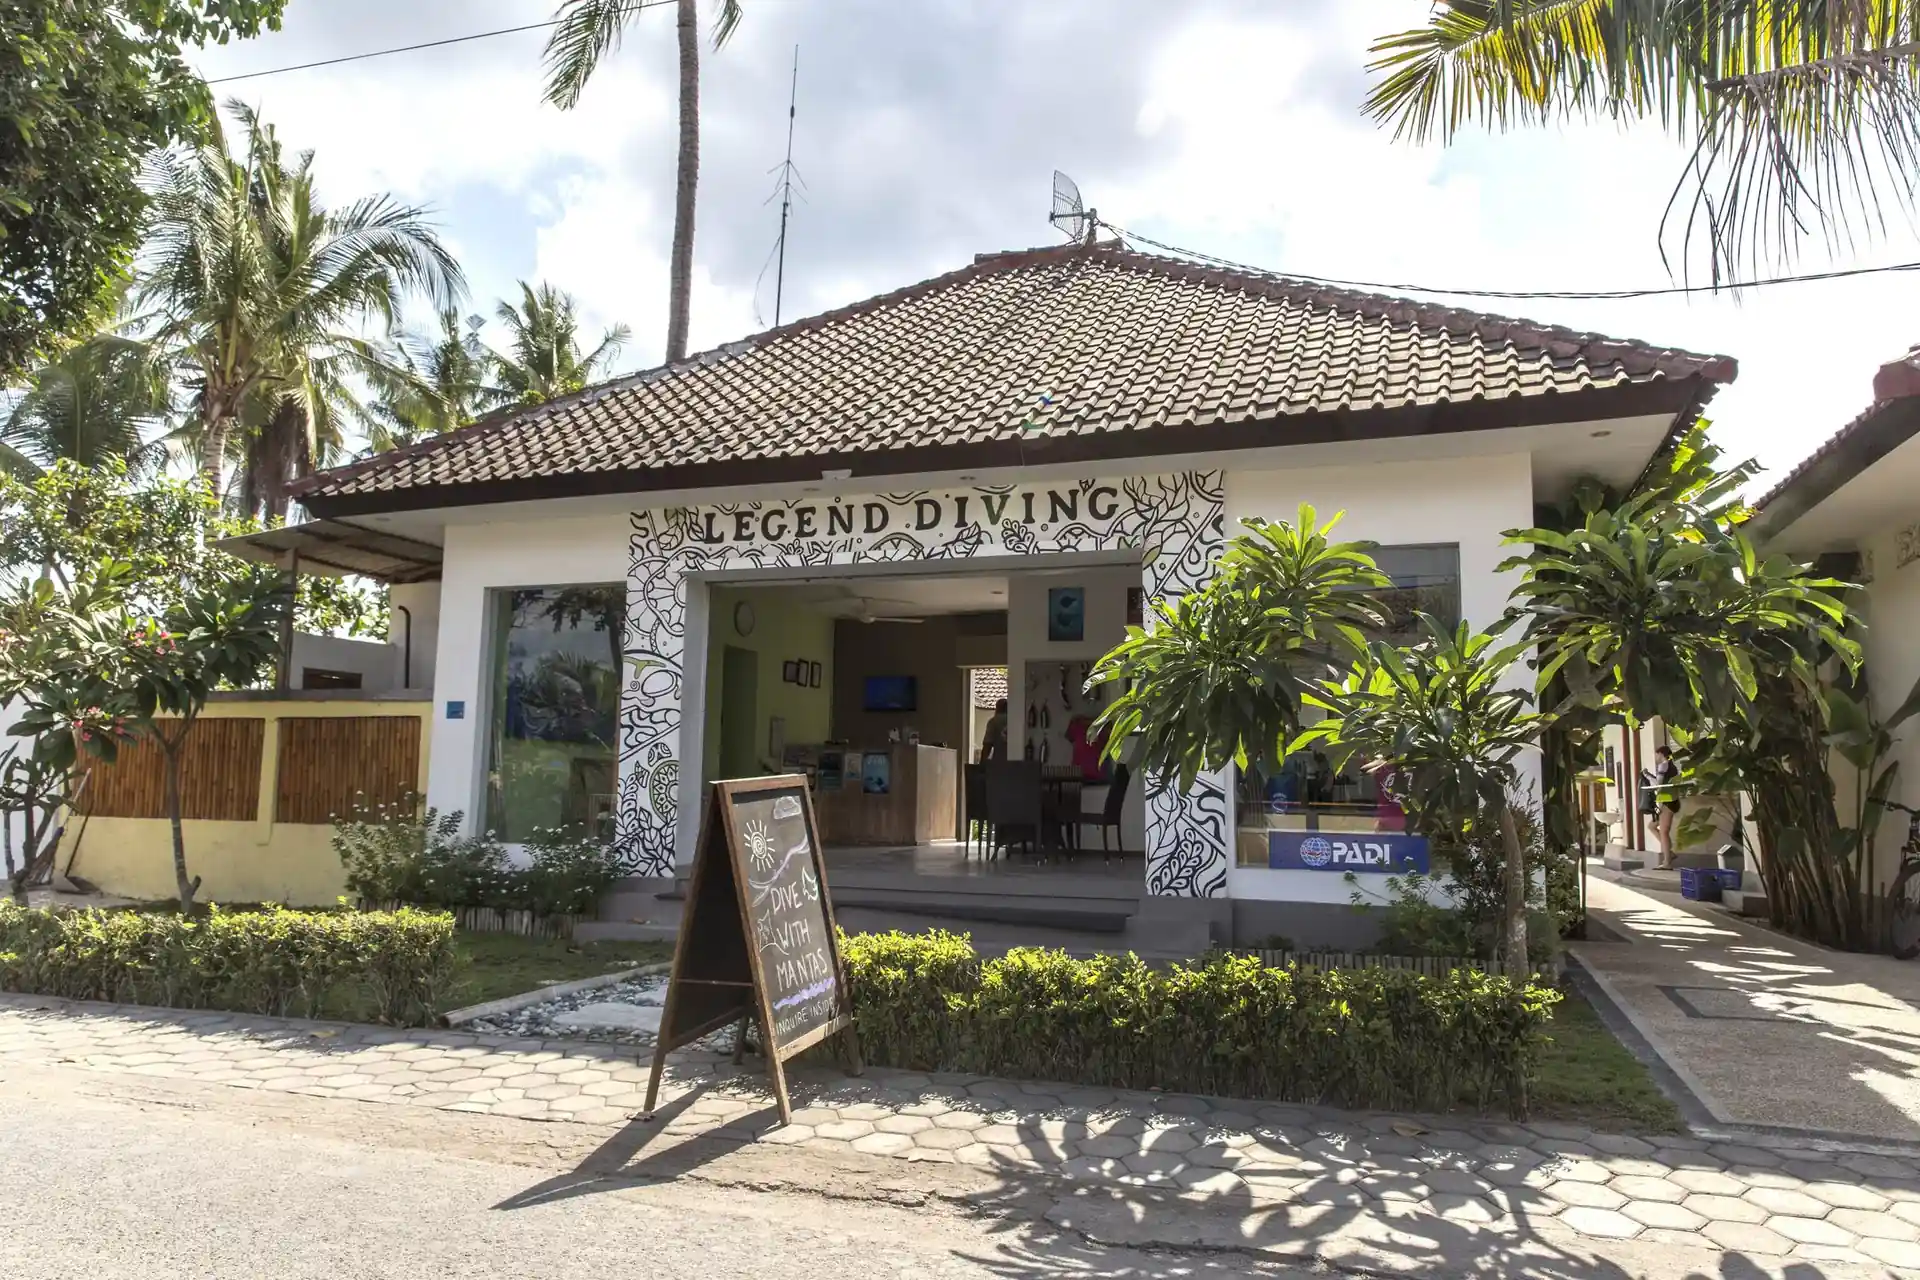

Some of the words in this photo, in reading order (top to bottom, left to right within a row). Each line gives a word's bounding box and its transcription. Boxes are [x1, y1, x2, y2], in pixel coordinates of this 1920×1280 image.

[704, 502, 889, 544] LEGEND
[915, 487, 1119, 531] DIVING
[1332, 842, 1391, 865] PADI
[770, 882, 803, 914] DIVE
[776, 919, 811, 949] WITH
[776, 948, 828, 992] MANTAS
[776, 1006, 808, 1036] INQUIRE
